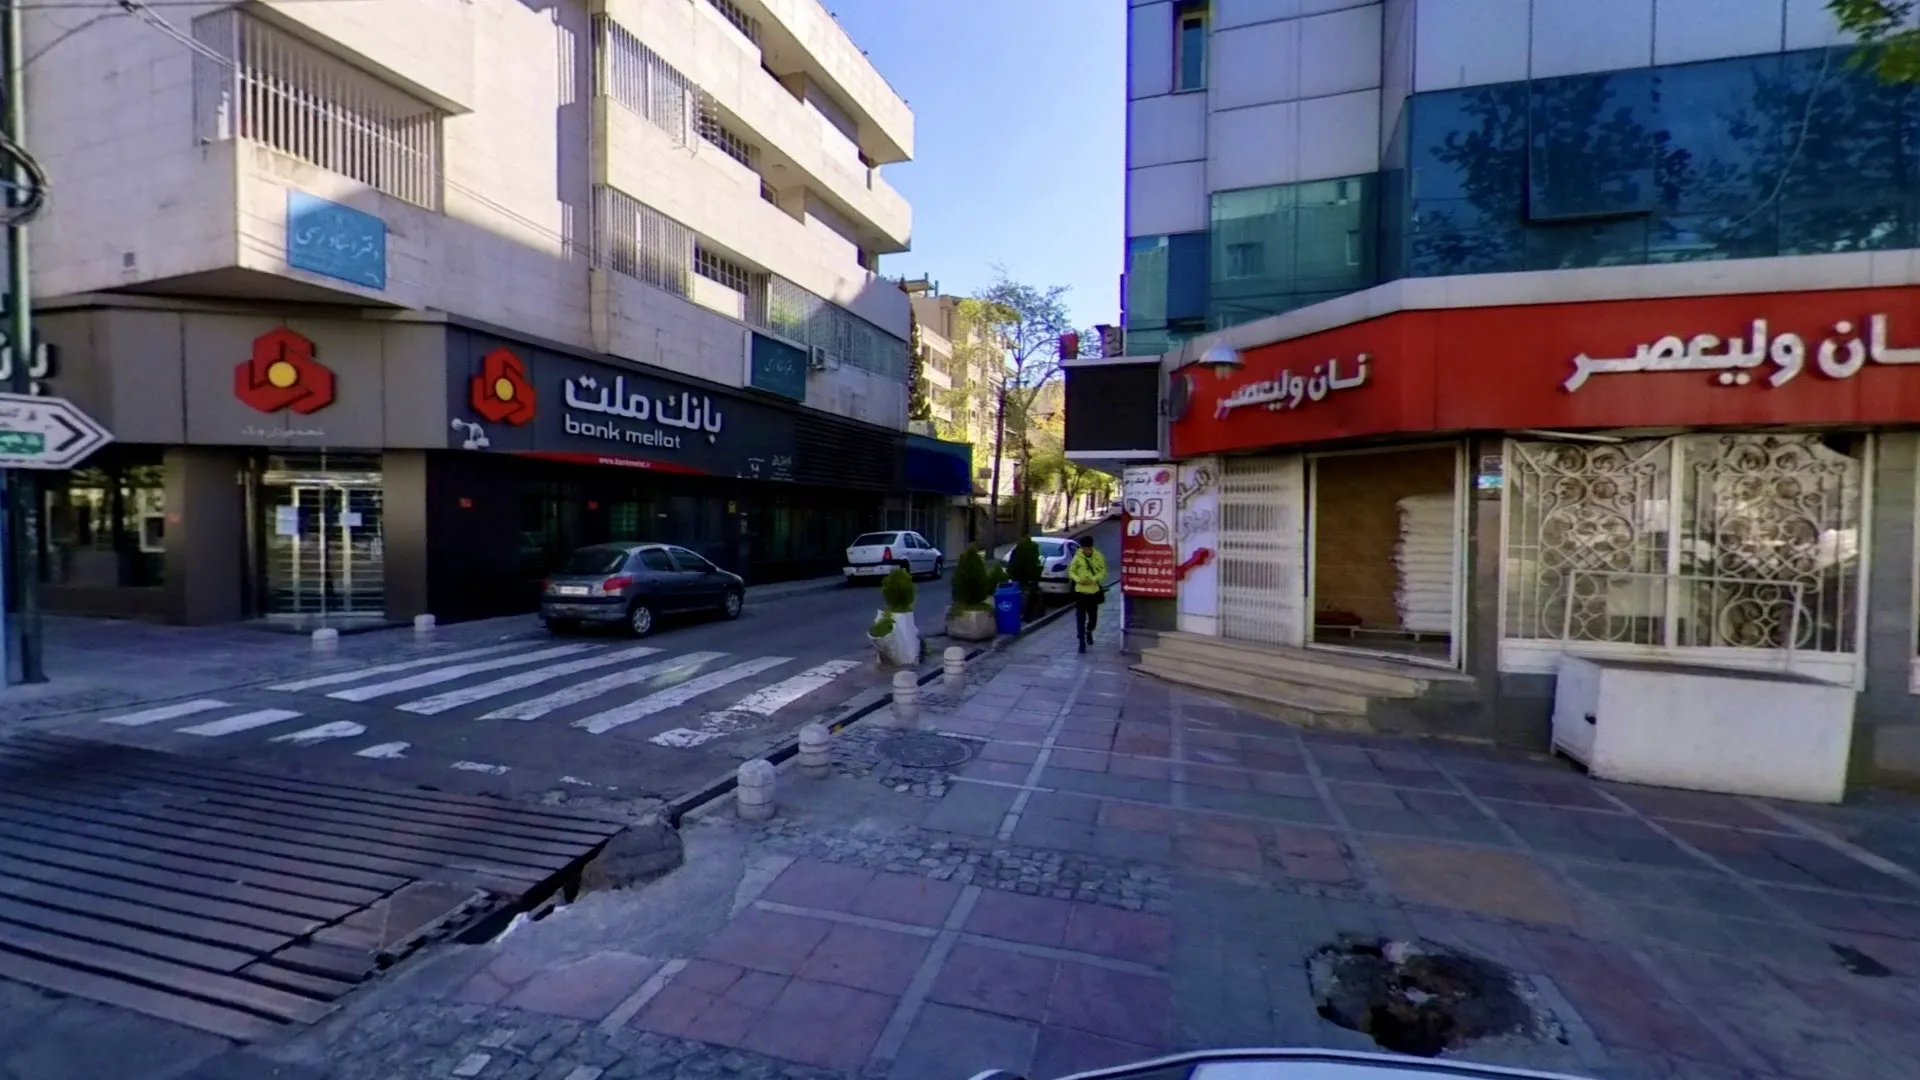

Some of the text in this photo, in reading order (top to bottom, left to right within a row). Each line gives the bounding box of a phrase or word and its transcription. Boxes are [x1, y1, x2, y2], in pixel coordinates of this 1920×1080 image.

[1308, 353, 1369, 401] نان
[565, 375, 650, 421] ملت
[565, 413, 681, 448] bank mellat
[1147, 502, 1156, 515] F
